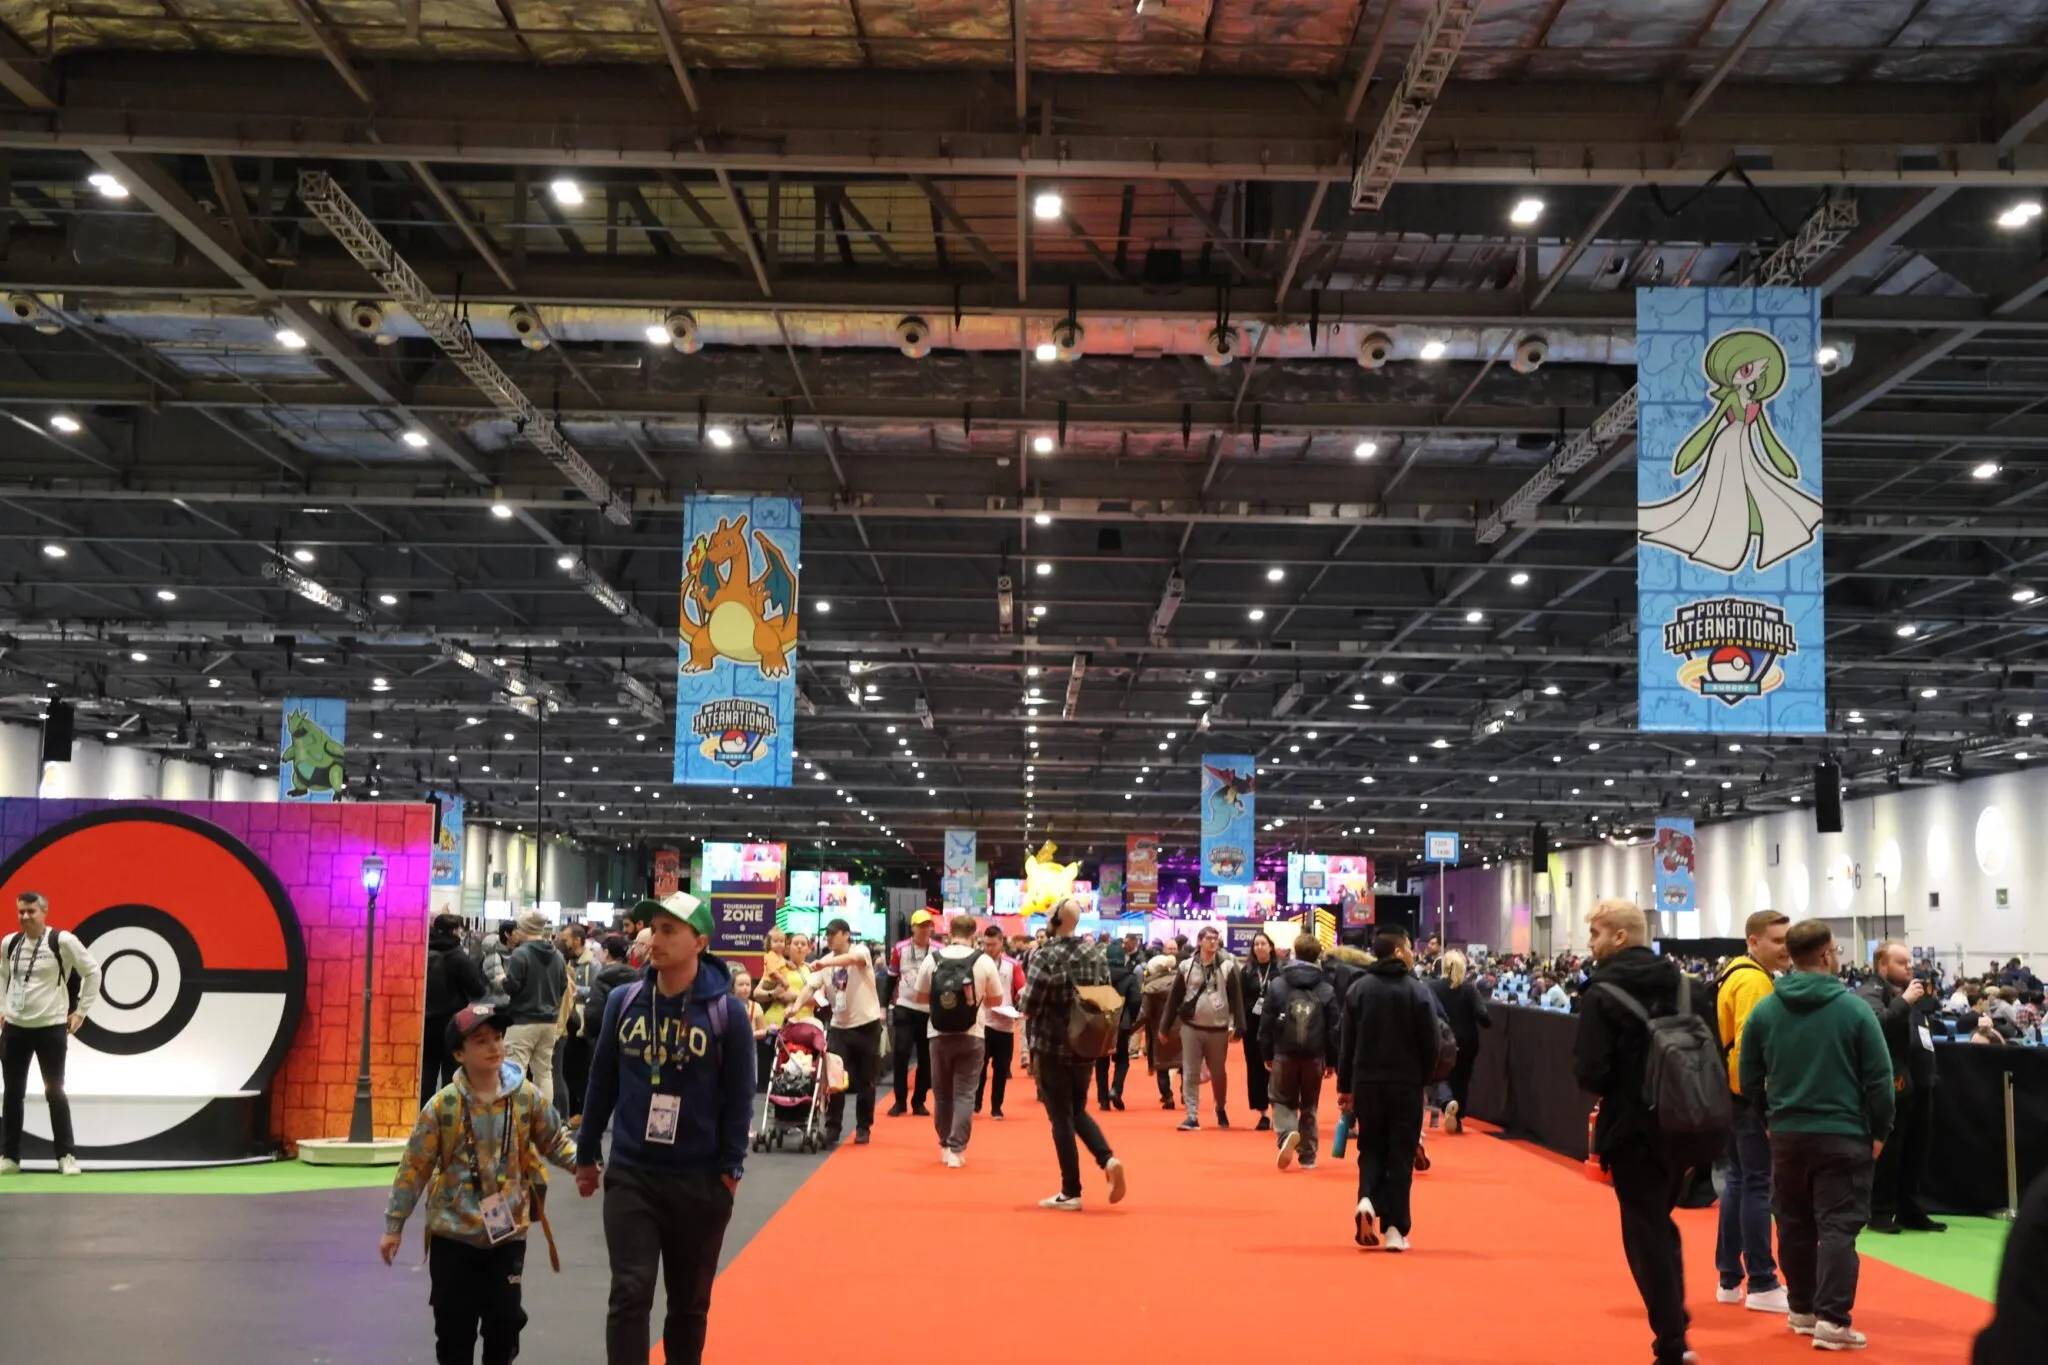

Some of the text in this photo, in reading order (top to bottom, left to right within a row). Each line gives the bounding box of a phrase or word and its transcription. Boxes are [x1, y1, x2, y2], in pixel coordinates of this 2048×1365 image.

[1697, 601, 1763, 618] POKÉMON
[1667, 617, 1794, 649] INTERNATIONAL
[1675, 639, 1786, 653] CHAMPIONSHIPS
[714, 699, 757, 712] POKÉMON
[695, 711, 776, 731] INTERNATIONAL
[723, 910, 763, 922] ZONE
